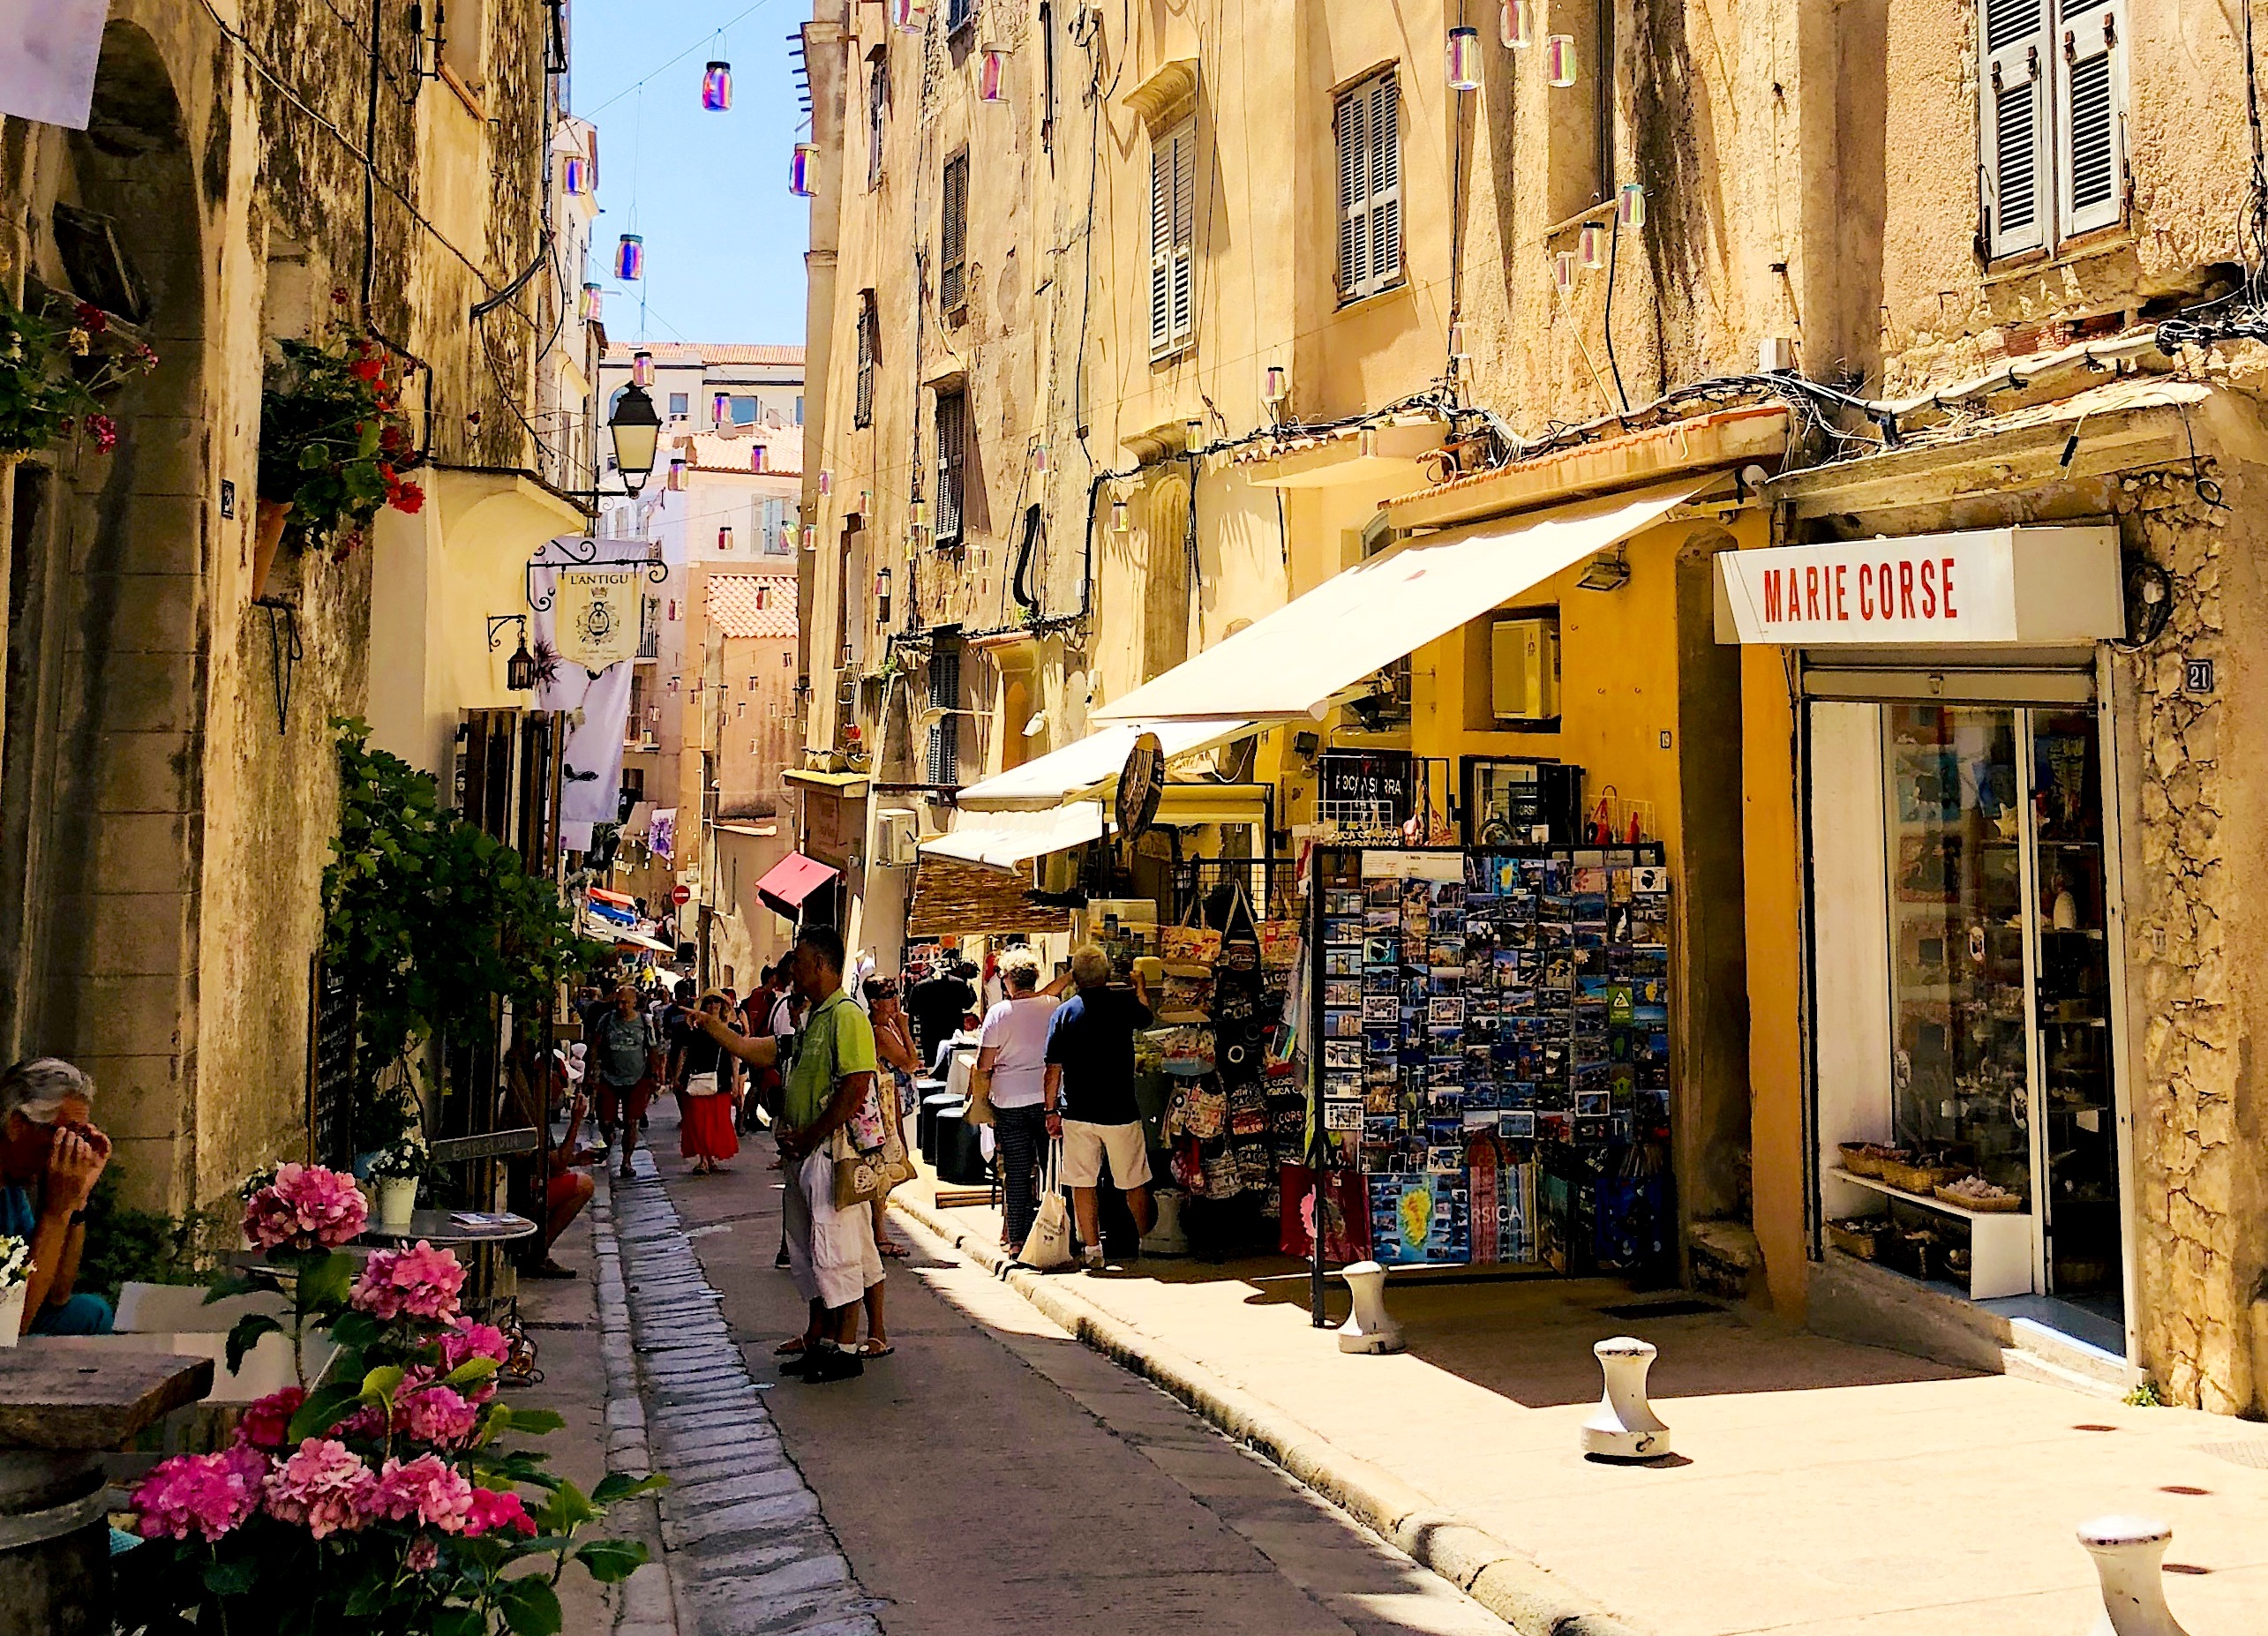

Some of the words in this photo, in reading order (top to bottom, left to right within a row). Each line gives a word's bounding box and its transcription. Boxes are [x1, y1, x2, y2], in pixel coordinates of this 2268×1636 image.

[570, 574, 628, 585] L'ANTIGU
[1764, 565, 1849, 622] MARIE
[1859, 558, 1956, 621] CORSE
[2189, 665, 2207, 687] 21
[1661, 732, 1671, 748] 19
